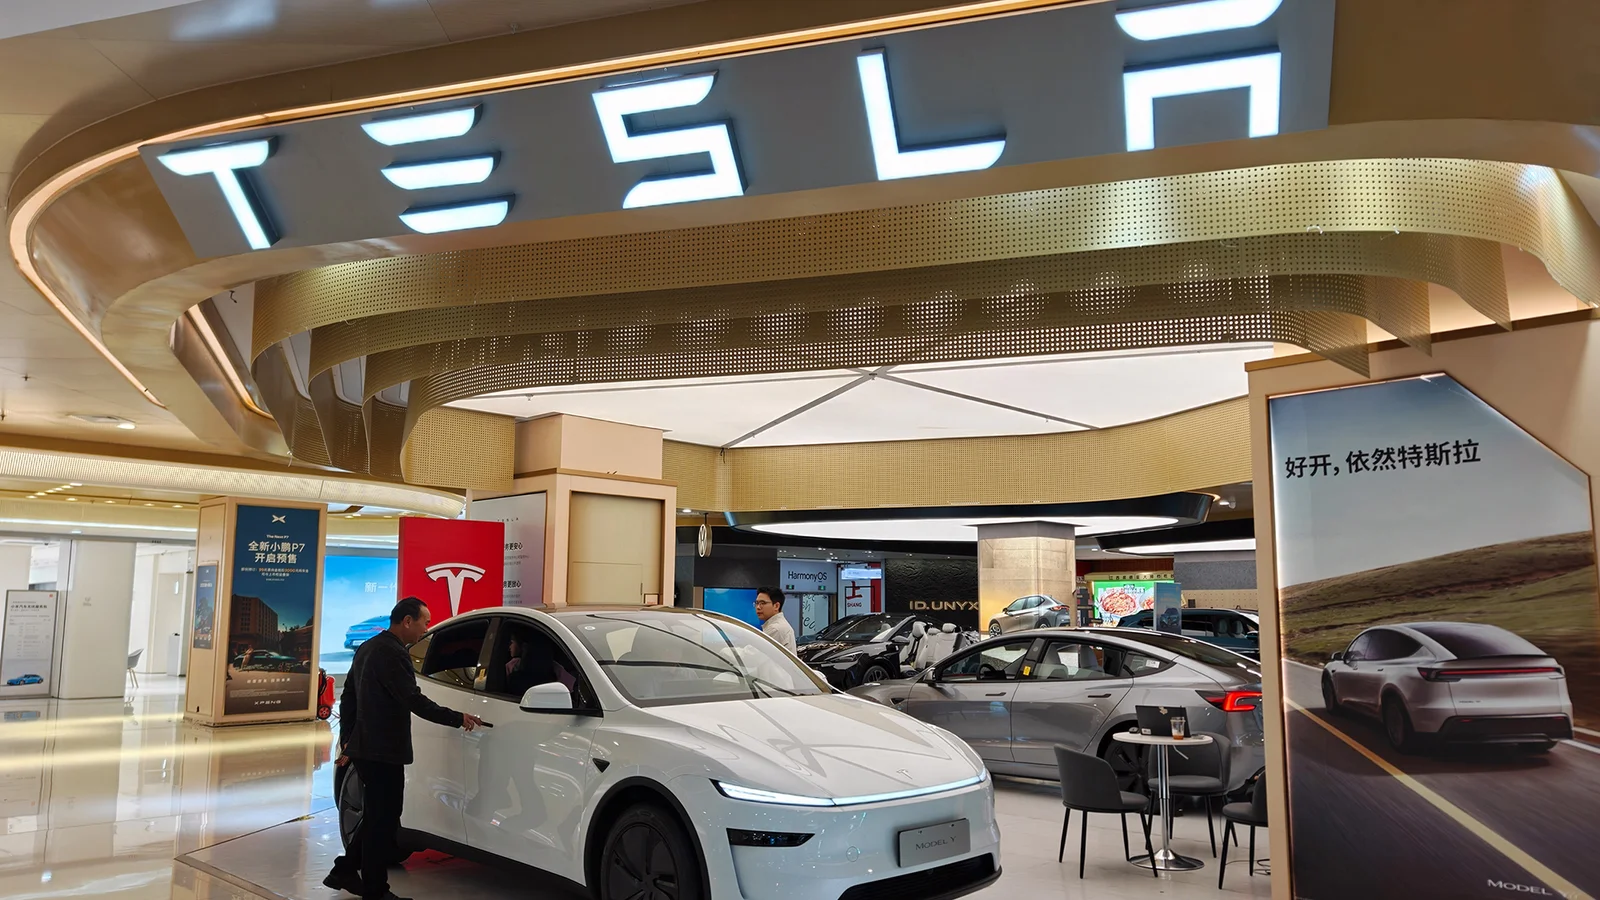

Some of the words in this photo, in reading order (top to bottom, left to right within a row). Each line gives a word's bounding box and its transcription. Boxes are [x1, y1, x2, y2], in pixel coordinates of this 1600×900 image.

[157, 0, 1282, 250] TESLA
[248, 541, 305, 552] 全新小鹏P7
[254, 552, 297, 563] 开启预售
[787, 570, 828, 582] HarmonyOS
[909, 600, 979, 611] ID.UNYX
[915, 840, 948, 850] MODEL
[1487, 879, 1553, 896] MODEL
